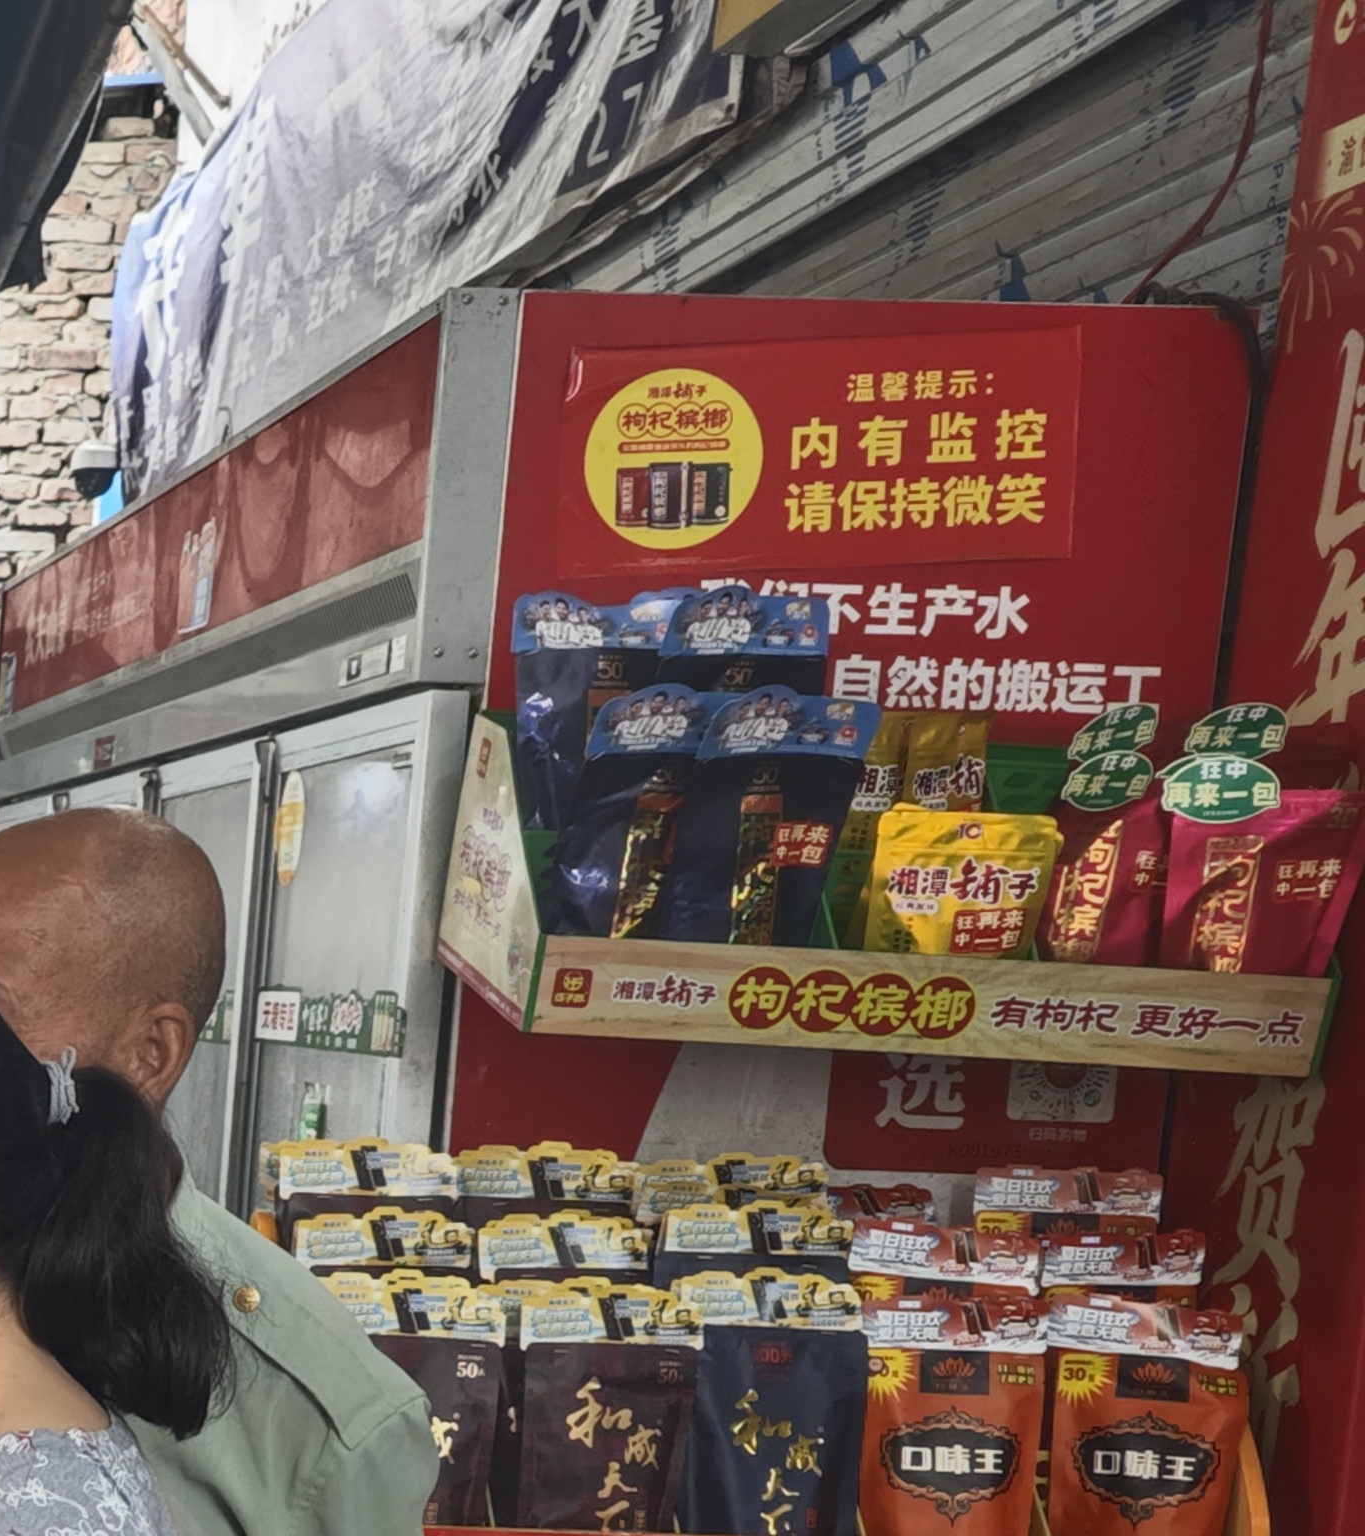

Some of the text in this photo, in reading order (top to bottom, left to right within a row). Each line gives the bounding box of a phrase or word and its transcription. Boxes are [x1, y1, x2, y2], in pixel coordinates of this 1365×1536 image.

[622, 408, 730, 432] 枸杞槟榔
[791, 409, 1048, 468] 内有监控
[784, 474, 1046, 533] 请保持微笑
[700, 578, 1029, 639] 不生产水
[833, 655, 1162, 715] 自然的搬运工
[1227, 707, 1268, 723] 狂中
[1073, 719, 1155, 754] 再来一包
[1189, 724, 1284, 749] 再来一包
[1100, 755, 1138, 771] 狂中
[1201, 761, 1247, 780] 狂中
[1066, 774, 1150, 797] 再来一包
[1169, 782, 1278, 808] 再来一包
[888, 858, 1038, 905] 湘潭铺子
[613, 974, 717, 1008] 湘潭铺子
[735, 976, 972, 1031] 枸杞槟榔
[991, 996, 1304, 1045] 有枸杞 更好一点
[901, 1444, 1004, 1475] 口味王
[1093, 1449, 1197, 1482] 口味王
